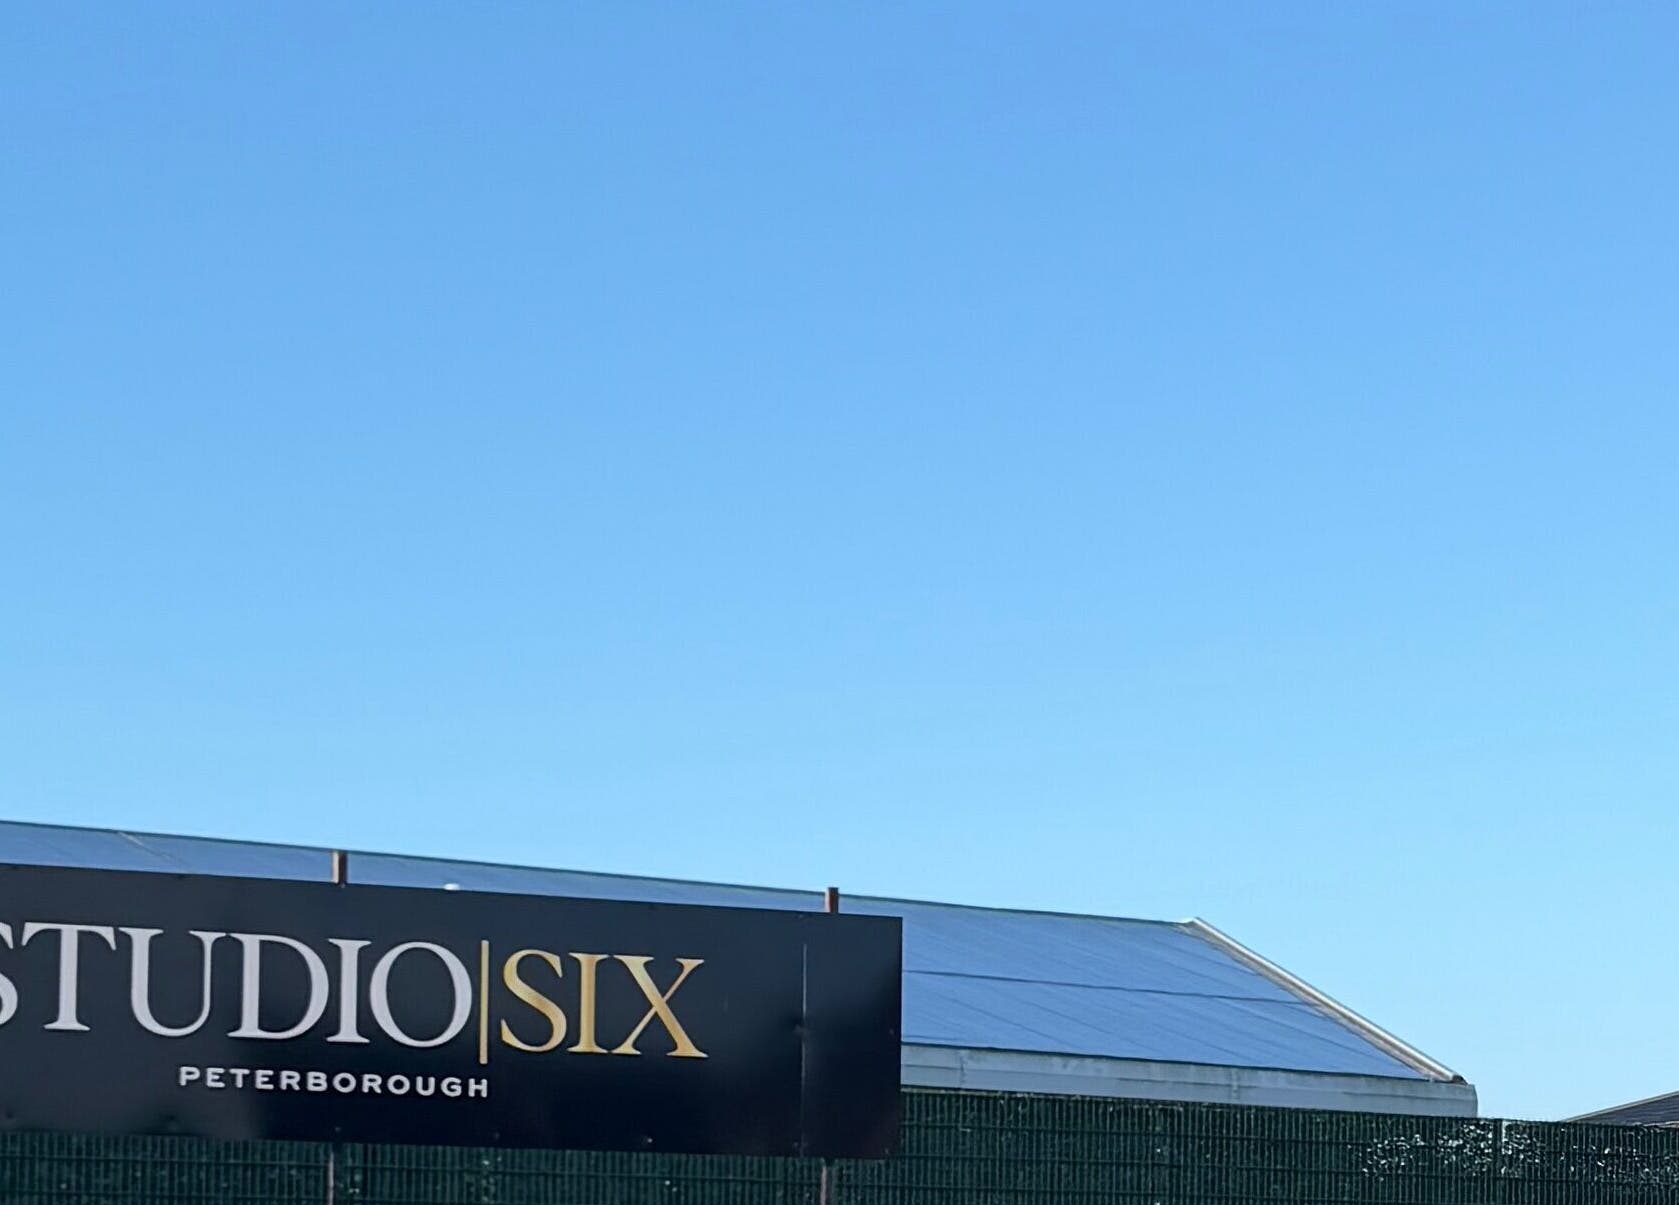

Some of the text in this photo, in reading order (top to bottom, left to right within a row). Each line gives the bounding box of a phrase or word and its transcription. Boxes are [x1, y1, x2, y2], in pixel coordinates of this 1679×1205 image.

[0, 921, 709, 1058] TUDIO SIX
[179, 1066, 488, 1098] PETERBOROUGH
